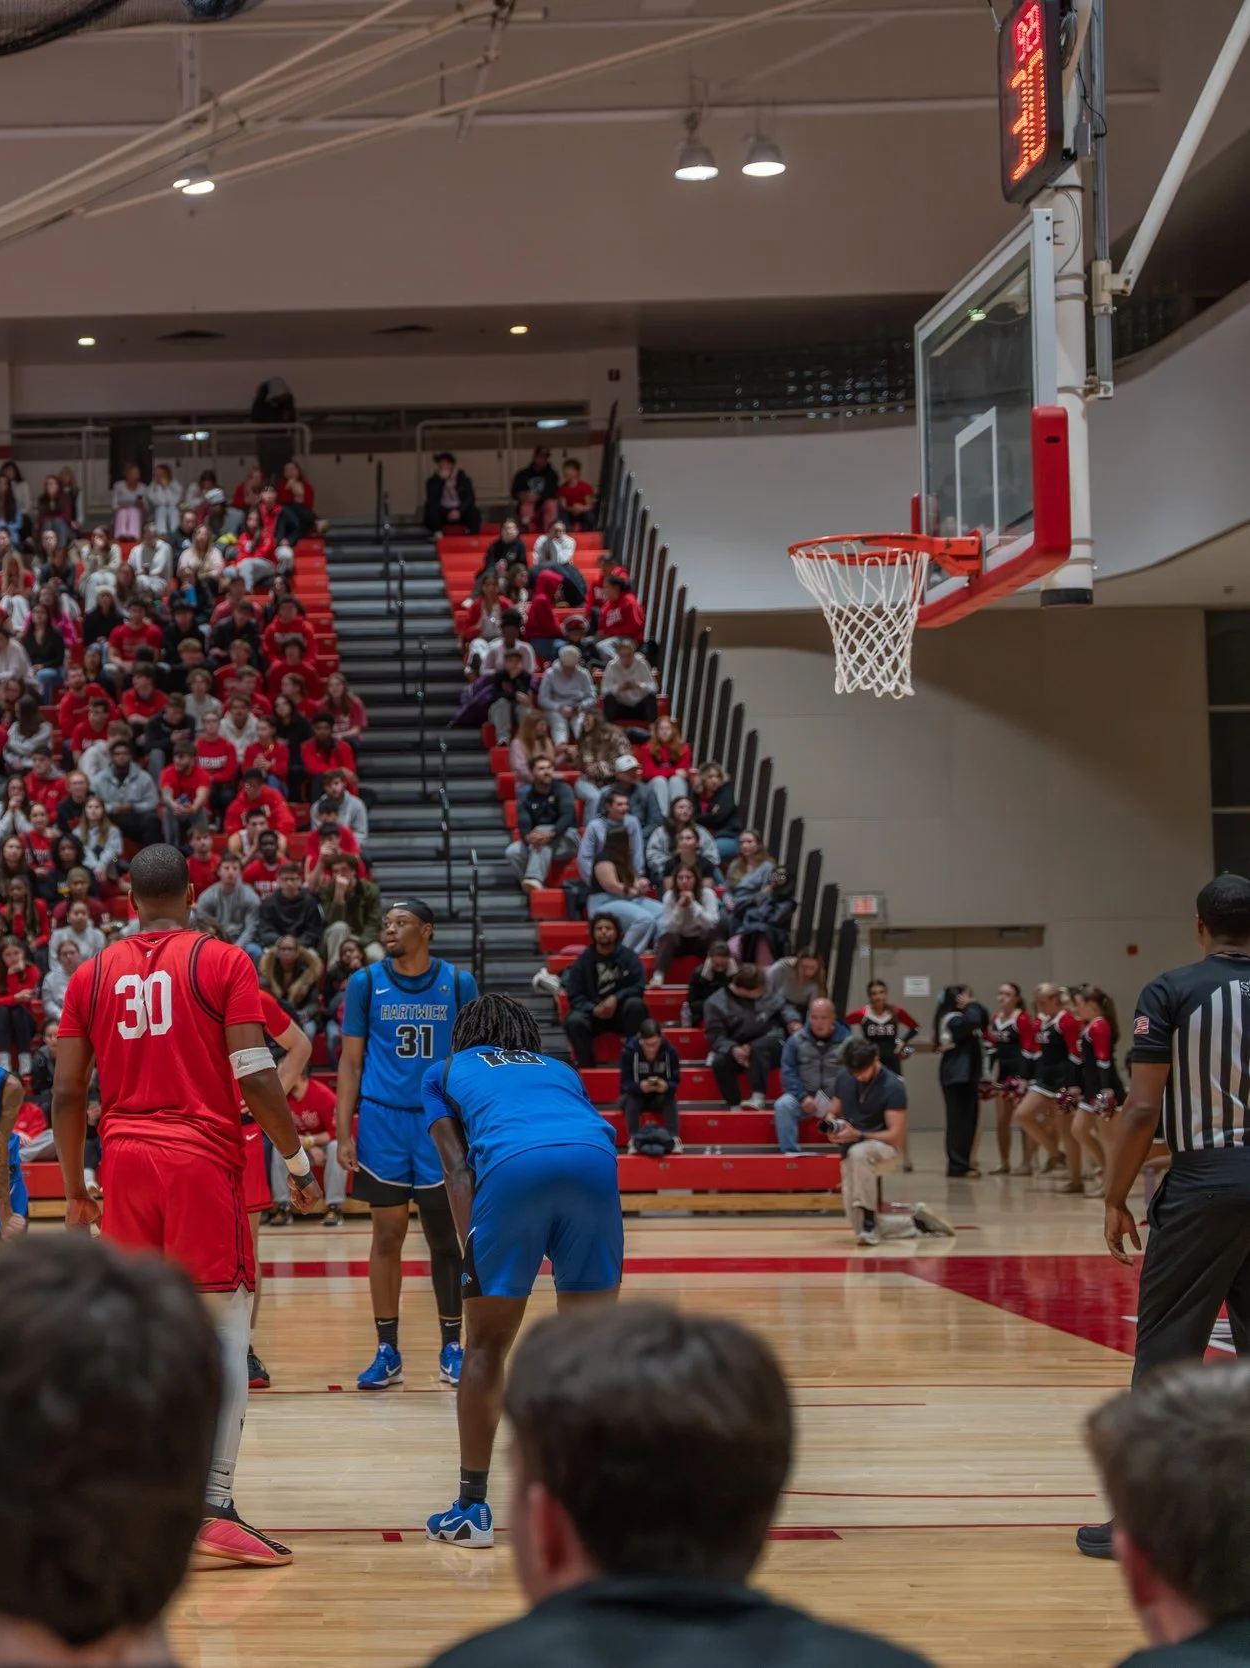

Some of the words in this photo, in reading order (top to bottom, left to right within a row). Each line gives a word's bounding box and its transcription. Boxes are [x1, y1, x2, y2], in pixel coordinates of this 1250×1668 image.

[114, 970, 172, 1040] 30
[380, 1004, 448, 1021] HARTWICK
[395, 1024, 434, 1059] 31
